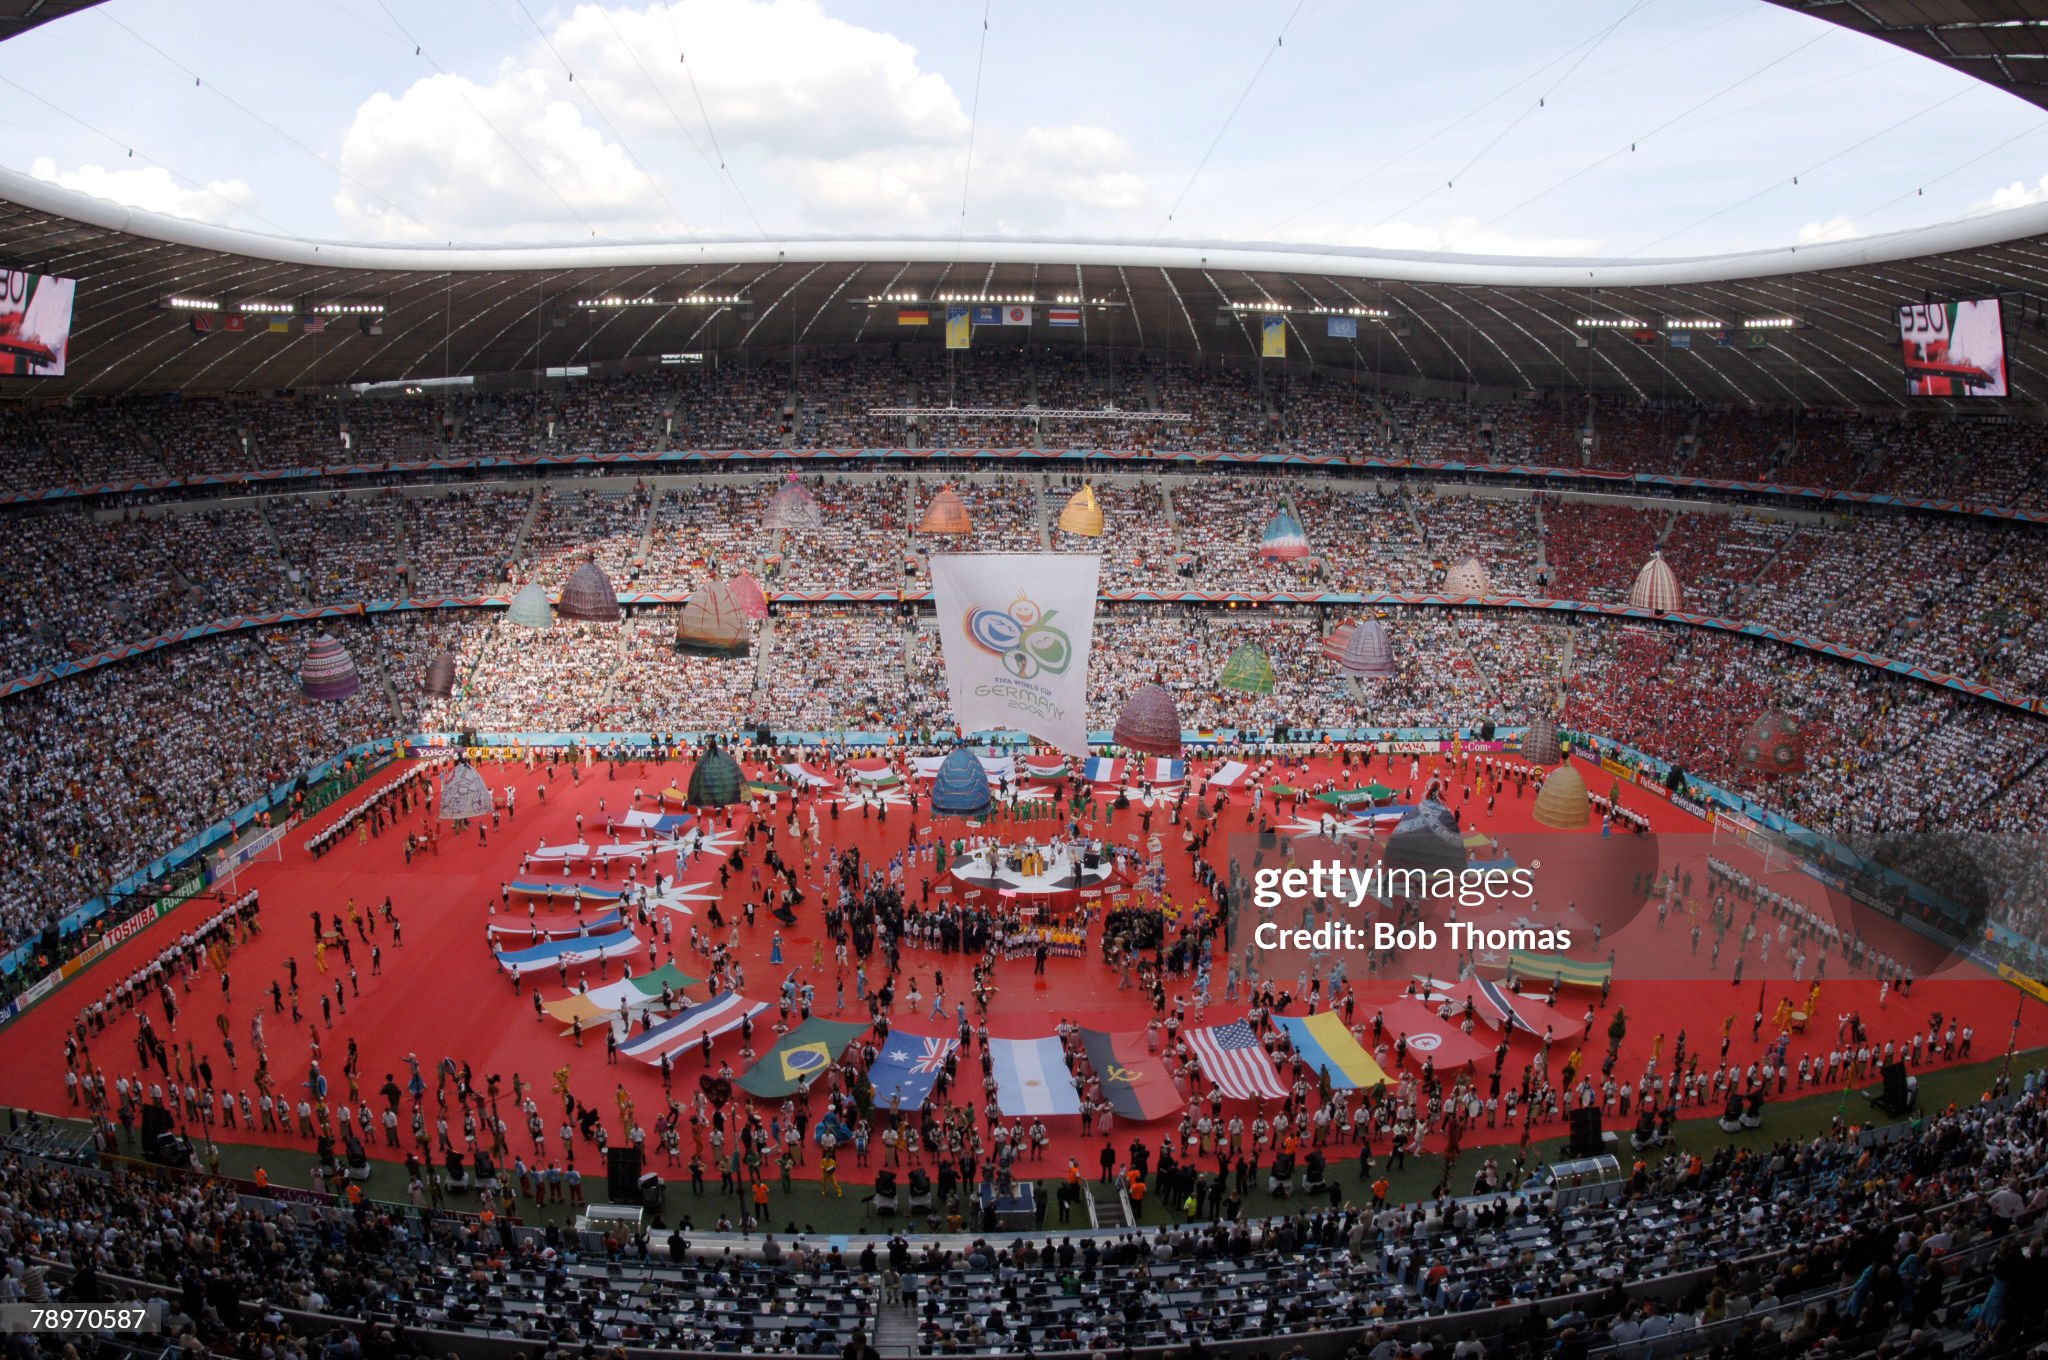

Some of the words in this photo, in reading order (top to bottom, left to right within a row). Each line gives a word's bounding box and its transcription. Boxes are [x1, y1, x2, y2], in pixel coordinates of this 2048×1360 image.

[995, 677, 1012, 685] FIFA
[1014, 679, 1039, 691] WORLD
[1040, 687, 1052, 696] CUP
[974, 684, 1065, 721] GERMANY
[1008, 699, 1045, 719] 2006
[1678, 797, 1706, 819] HYUNDAI
[1802, 862, 1836, 885] MasterCard
[1867, 896, 1895, 916] adidas
[105, 906, 157, 946] TOSHIBA
